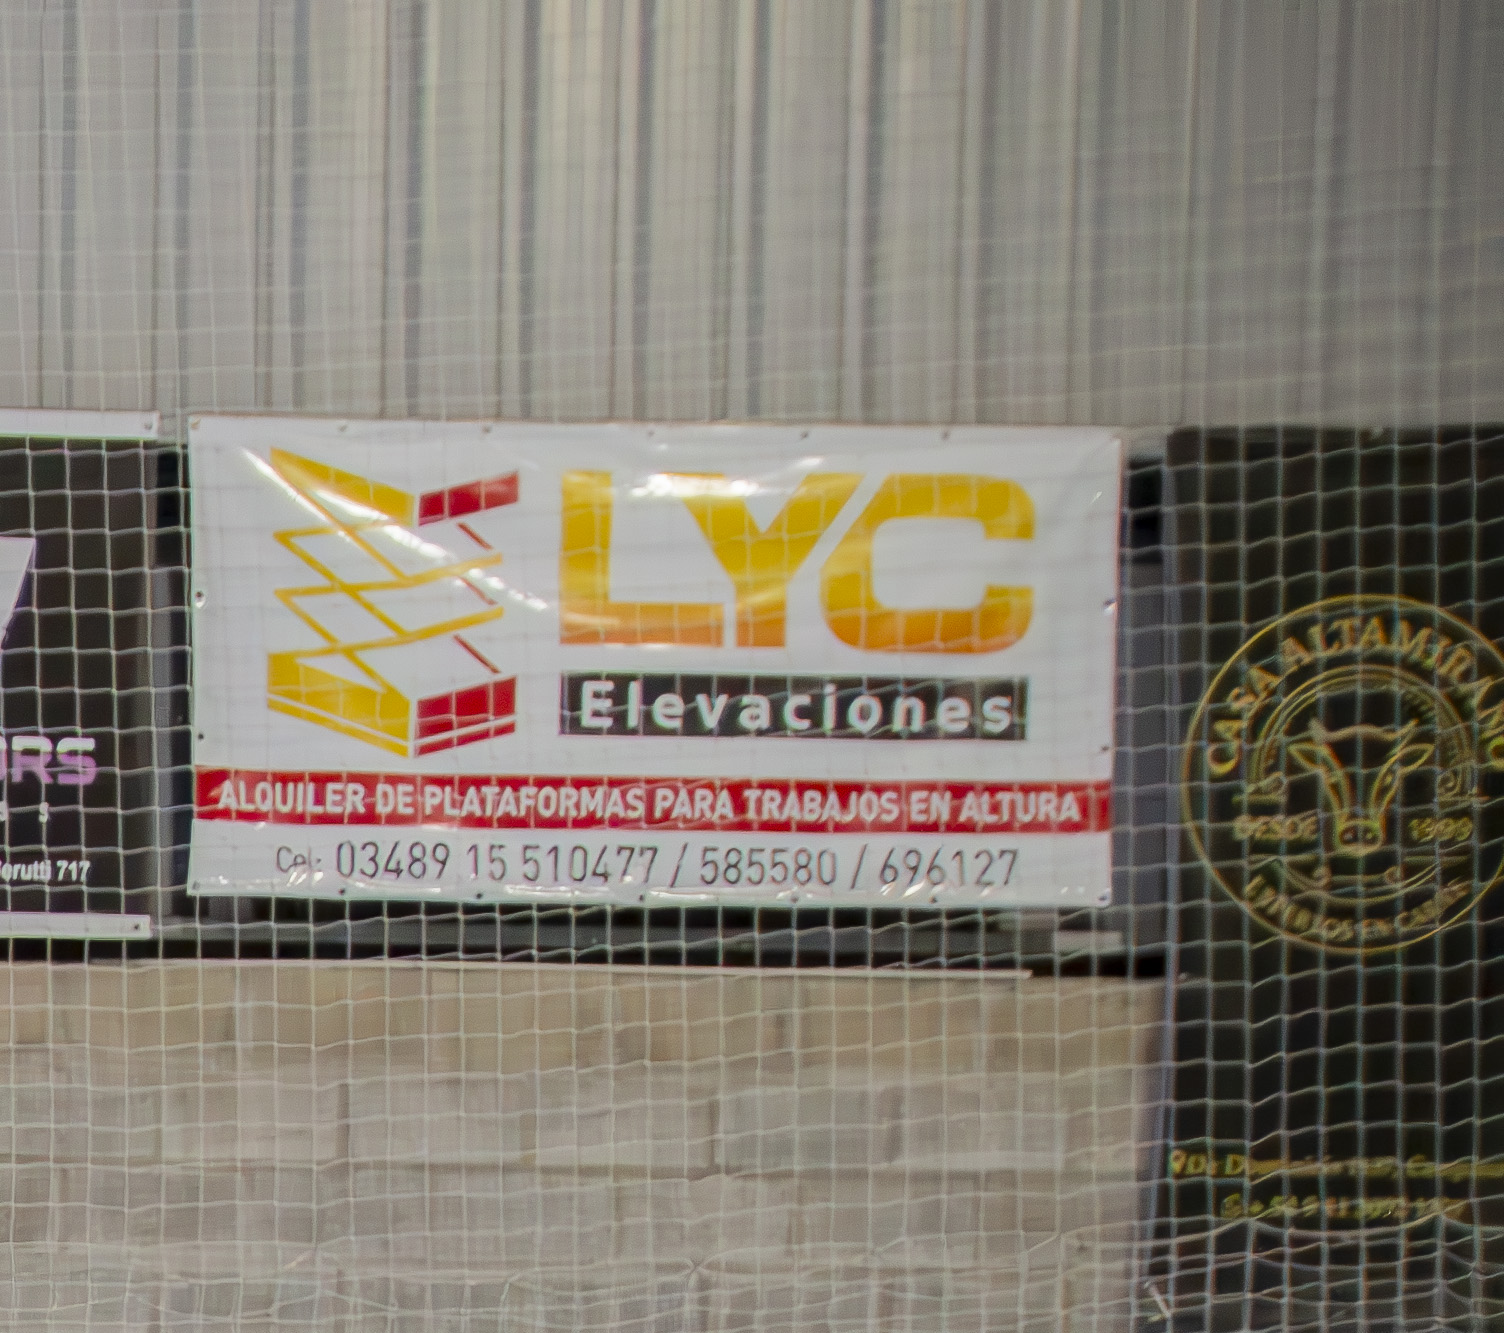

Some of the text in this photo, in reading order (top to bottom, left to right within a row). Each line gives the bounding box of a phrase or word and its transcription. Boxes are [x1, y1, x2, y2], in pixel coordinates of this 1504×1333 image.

[558, 470, 1036, 654] LYC
[578, 676, 1015, 735] Elevaciones
[217, 779, 1081, 824] ALQUILER DE PLATAFORMAS PARA TRABAJOS EN ALTURA
[56, 860, 92, 883] 717
[335, 840, 451, 880] 03489
[467, 842, 509, 882] 15
[521, 842, 659, 885] 510477
[698, 845, 837, 887] 585580
[878, 844, 1020, 890] 696127
